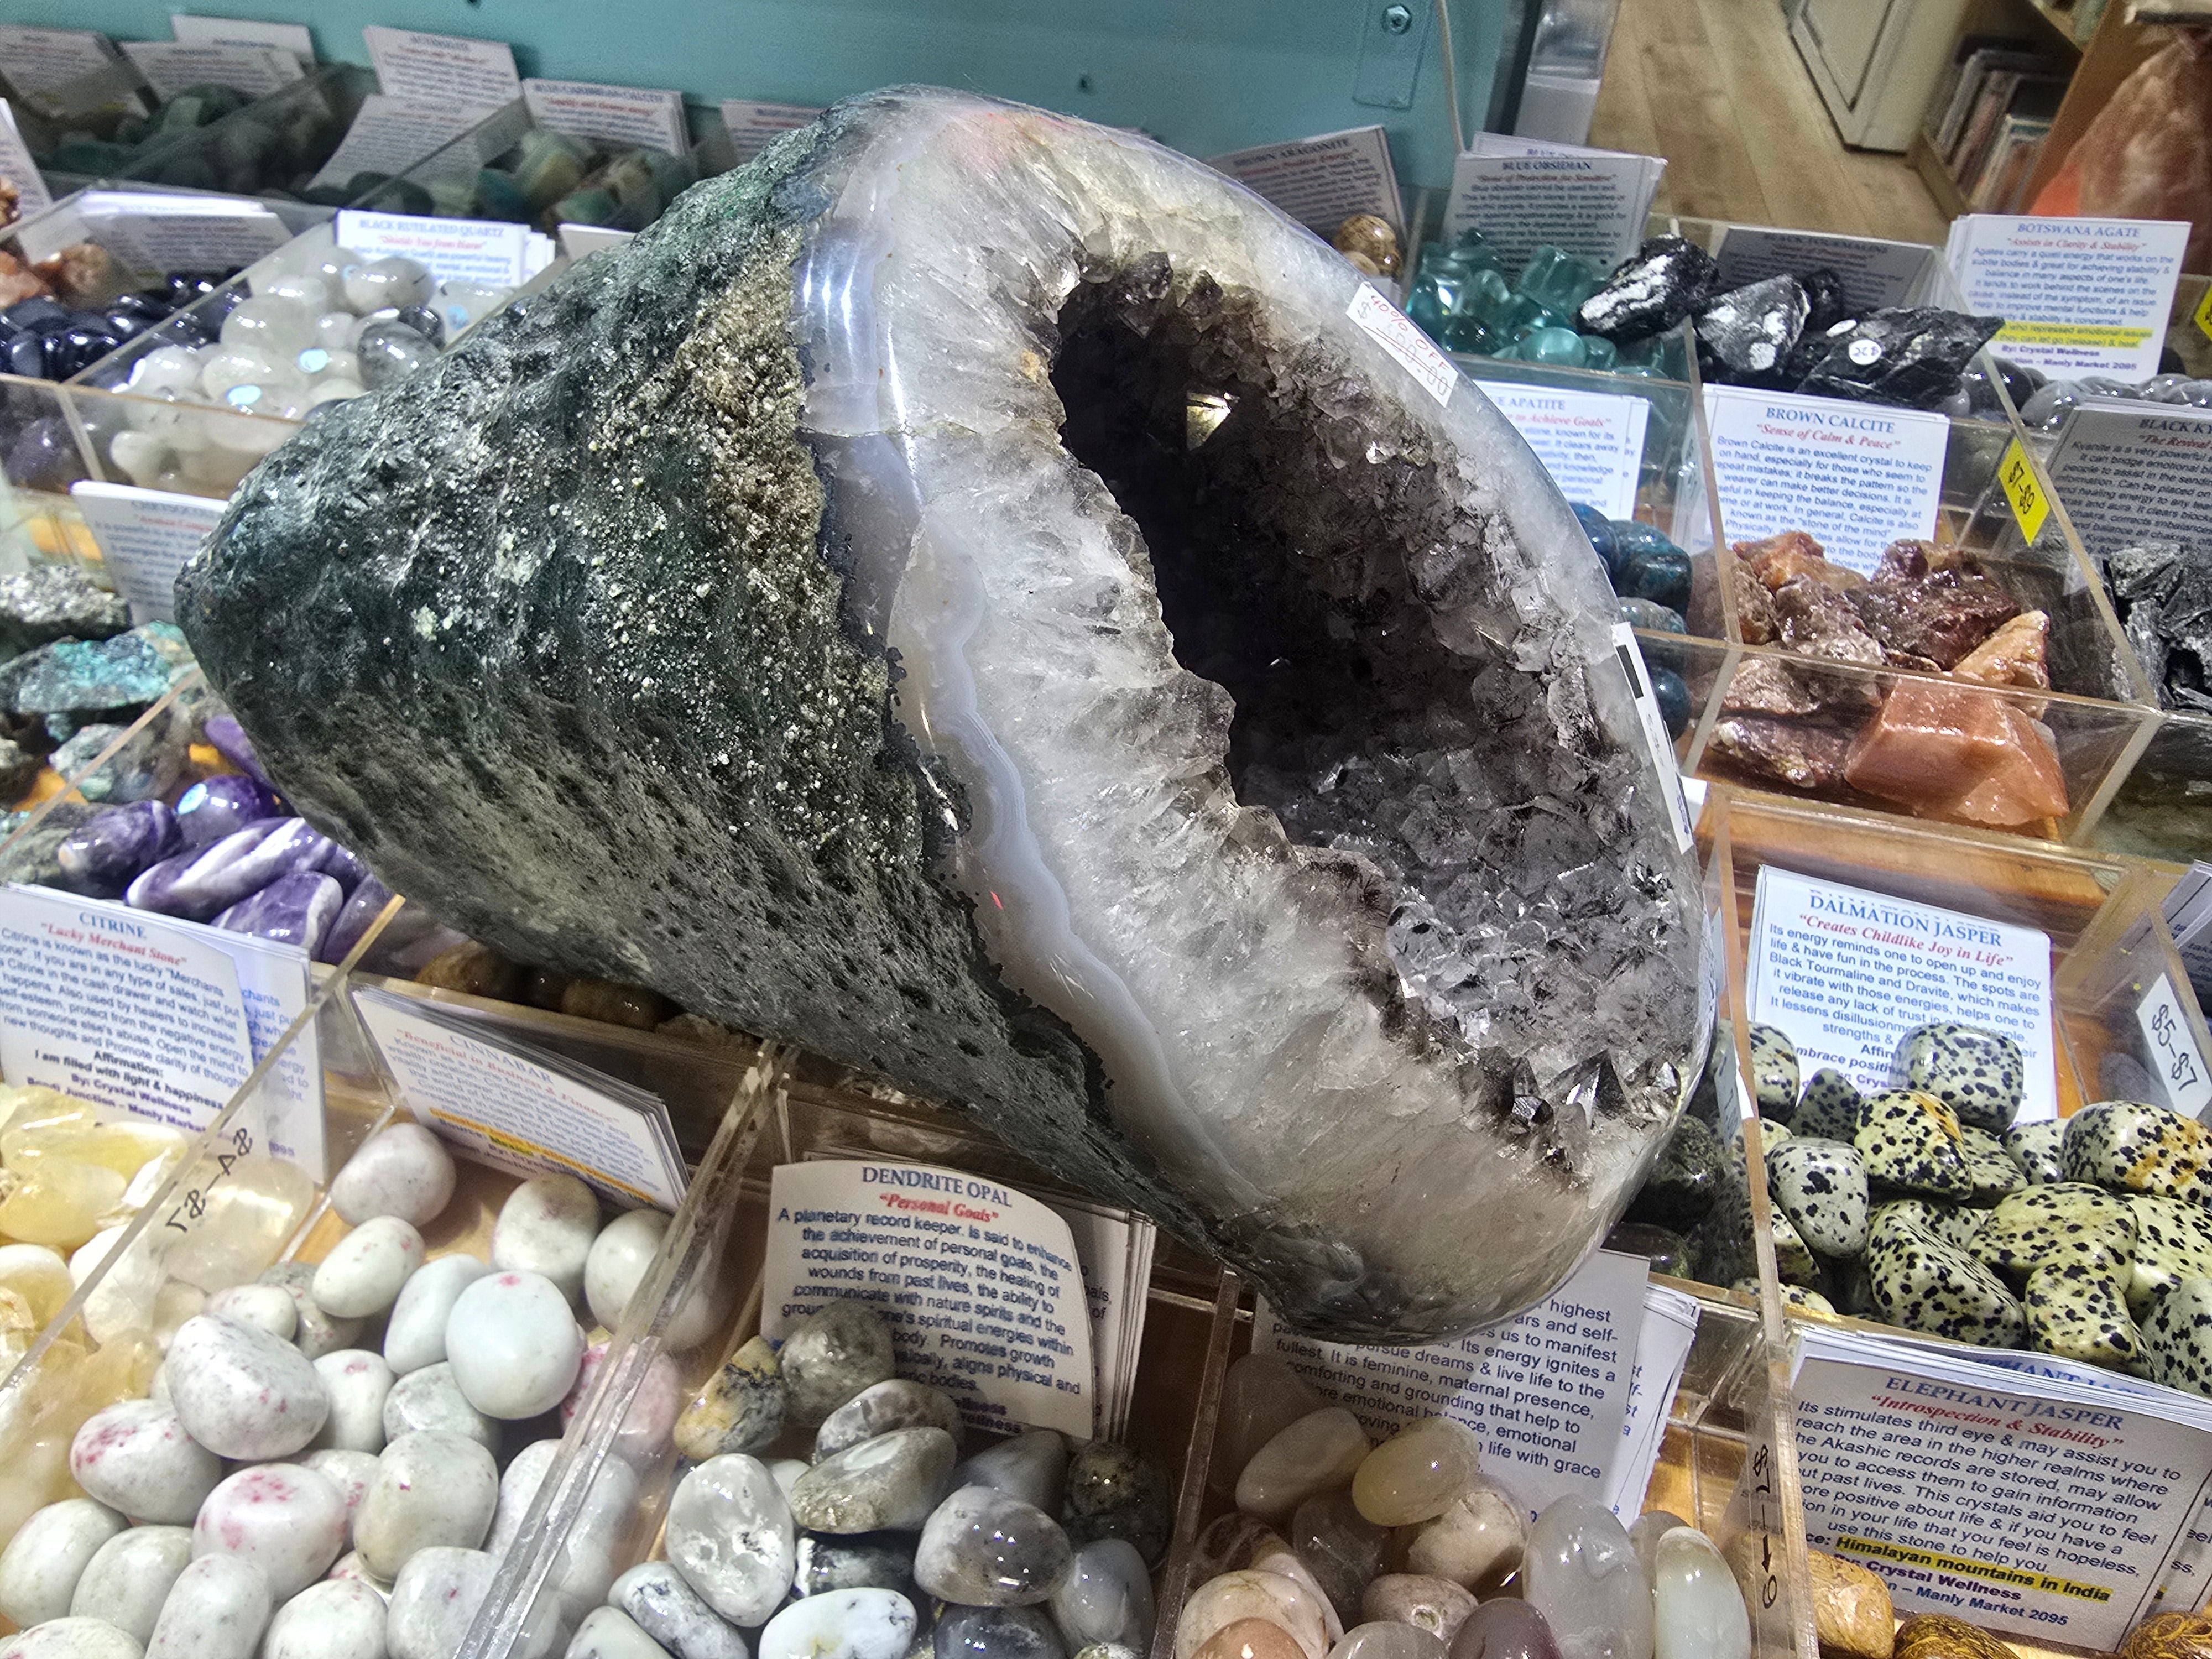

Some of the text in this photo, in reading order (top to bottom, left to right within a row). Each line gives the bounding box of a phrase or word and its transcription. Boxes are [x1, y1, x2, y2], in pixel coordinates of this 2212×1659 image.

[359, 219, 504, 237] BLACK RUTILATED QUARTZ
[2017, 223, 2138, 237] BOTSWANA AGATE
[1371, 295, 1408, 332] 40%
[1415, 338, 1449, 370] OFF
[1510, 398, 1565, 410] APATITE
[1766, 407, 1893, 433] BROWN CALCITE
[2138, 419, 2192, 432] BLACK
[1717, 435, 1748, 447] Brown
[1750, 439, 1785, 452] Calcite
[1786, 446, 1795, 454] is
[1813, 449, 1858, 462] excellent
[1859, 455, 1893, 466] crystal
[1895, 459, 1905, 468] to
[1907, 461, 1932, 472] keep
[79, 912, 147, 938] CITRINE
[1810, 895, 2001, 947] DALMATION JASPER
[1770, 923, 2041, 990] Its energy reminds one to open up and enjoy
[1861, 927, 1924, 950] Childlike
[1928, 941, 1952, 956] Joy
[1956, 946, 1970, 959] in
[1769, 951, 2039, 1016] Black Tourmaline and Dravite, which makes
[35, 1049, 224, 1112] I am filled with light & happiness
[449, 1035, 554, 1084] CINNABAR
[93, 1079, 136, 1098] Crystal
[139, 1092, 191, 1114] Wellness
[862, 1167, 1012, 1207] DENDRITE OPAL
[778, 1208, 1072, 1272] A planetary record keeper. Is said to enhance
[802, 1227, 825, 1241] the
[829, 1227, 920, 1248] achievement
[923, 1237, 938, 1250] of
[940, 1241, 998, 1262] personal
[1039, 1263, 1058, 1281] the
[1550, 1298, 1610, 1323] highest
[1415, 1349, 1604, 1399] dreams & live life to the
[1460, 1339, 1615, 1381] Its energy ignites a
[1371, 1380, 1580, 1433] and grounding that help to
[1885, 1376, 2124, 1430] ELEPHANT JASPER
[1798, 1400, 2181, 1480] Its stimulates third eye & may assist you to
[2005, 1419, 2023, 1431] &
[1795, 1418, 2168, 1495] reach the area in the higher realms where
[1835, 1536, 1931, 1564] Himalayan
[1936, 1558, 2035, 1585] mountains
[2039, 1577, 2058, 1590] in
[2062, 1582, 2110, 1601] India
[1865, 1560, 2021, 1600] Crystal Wellness
[1915, 1585, 2069, 1626] Manly Market 2095
